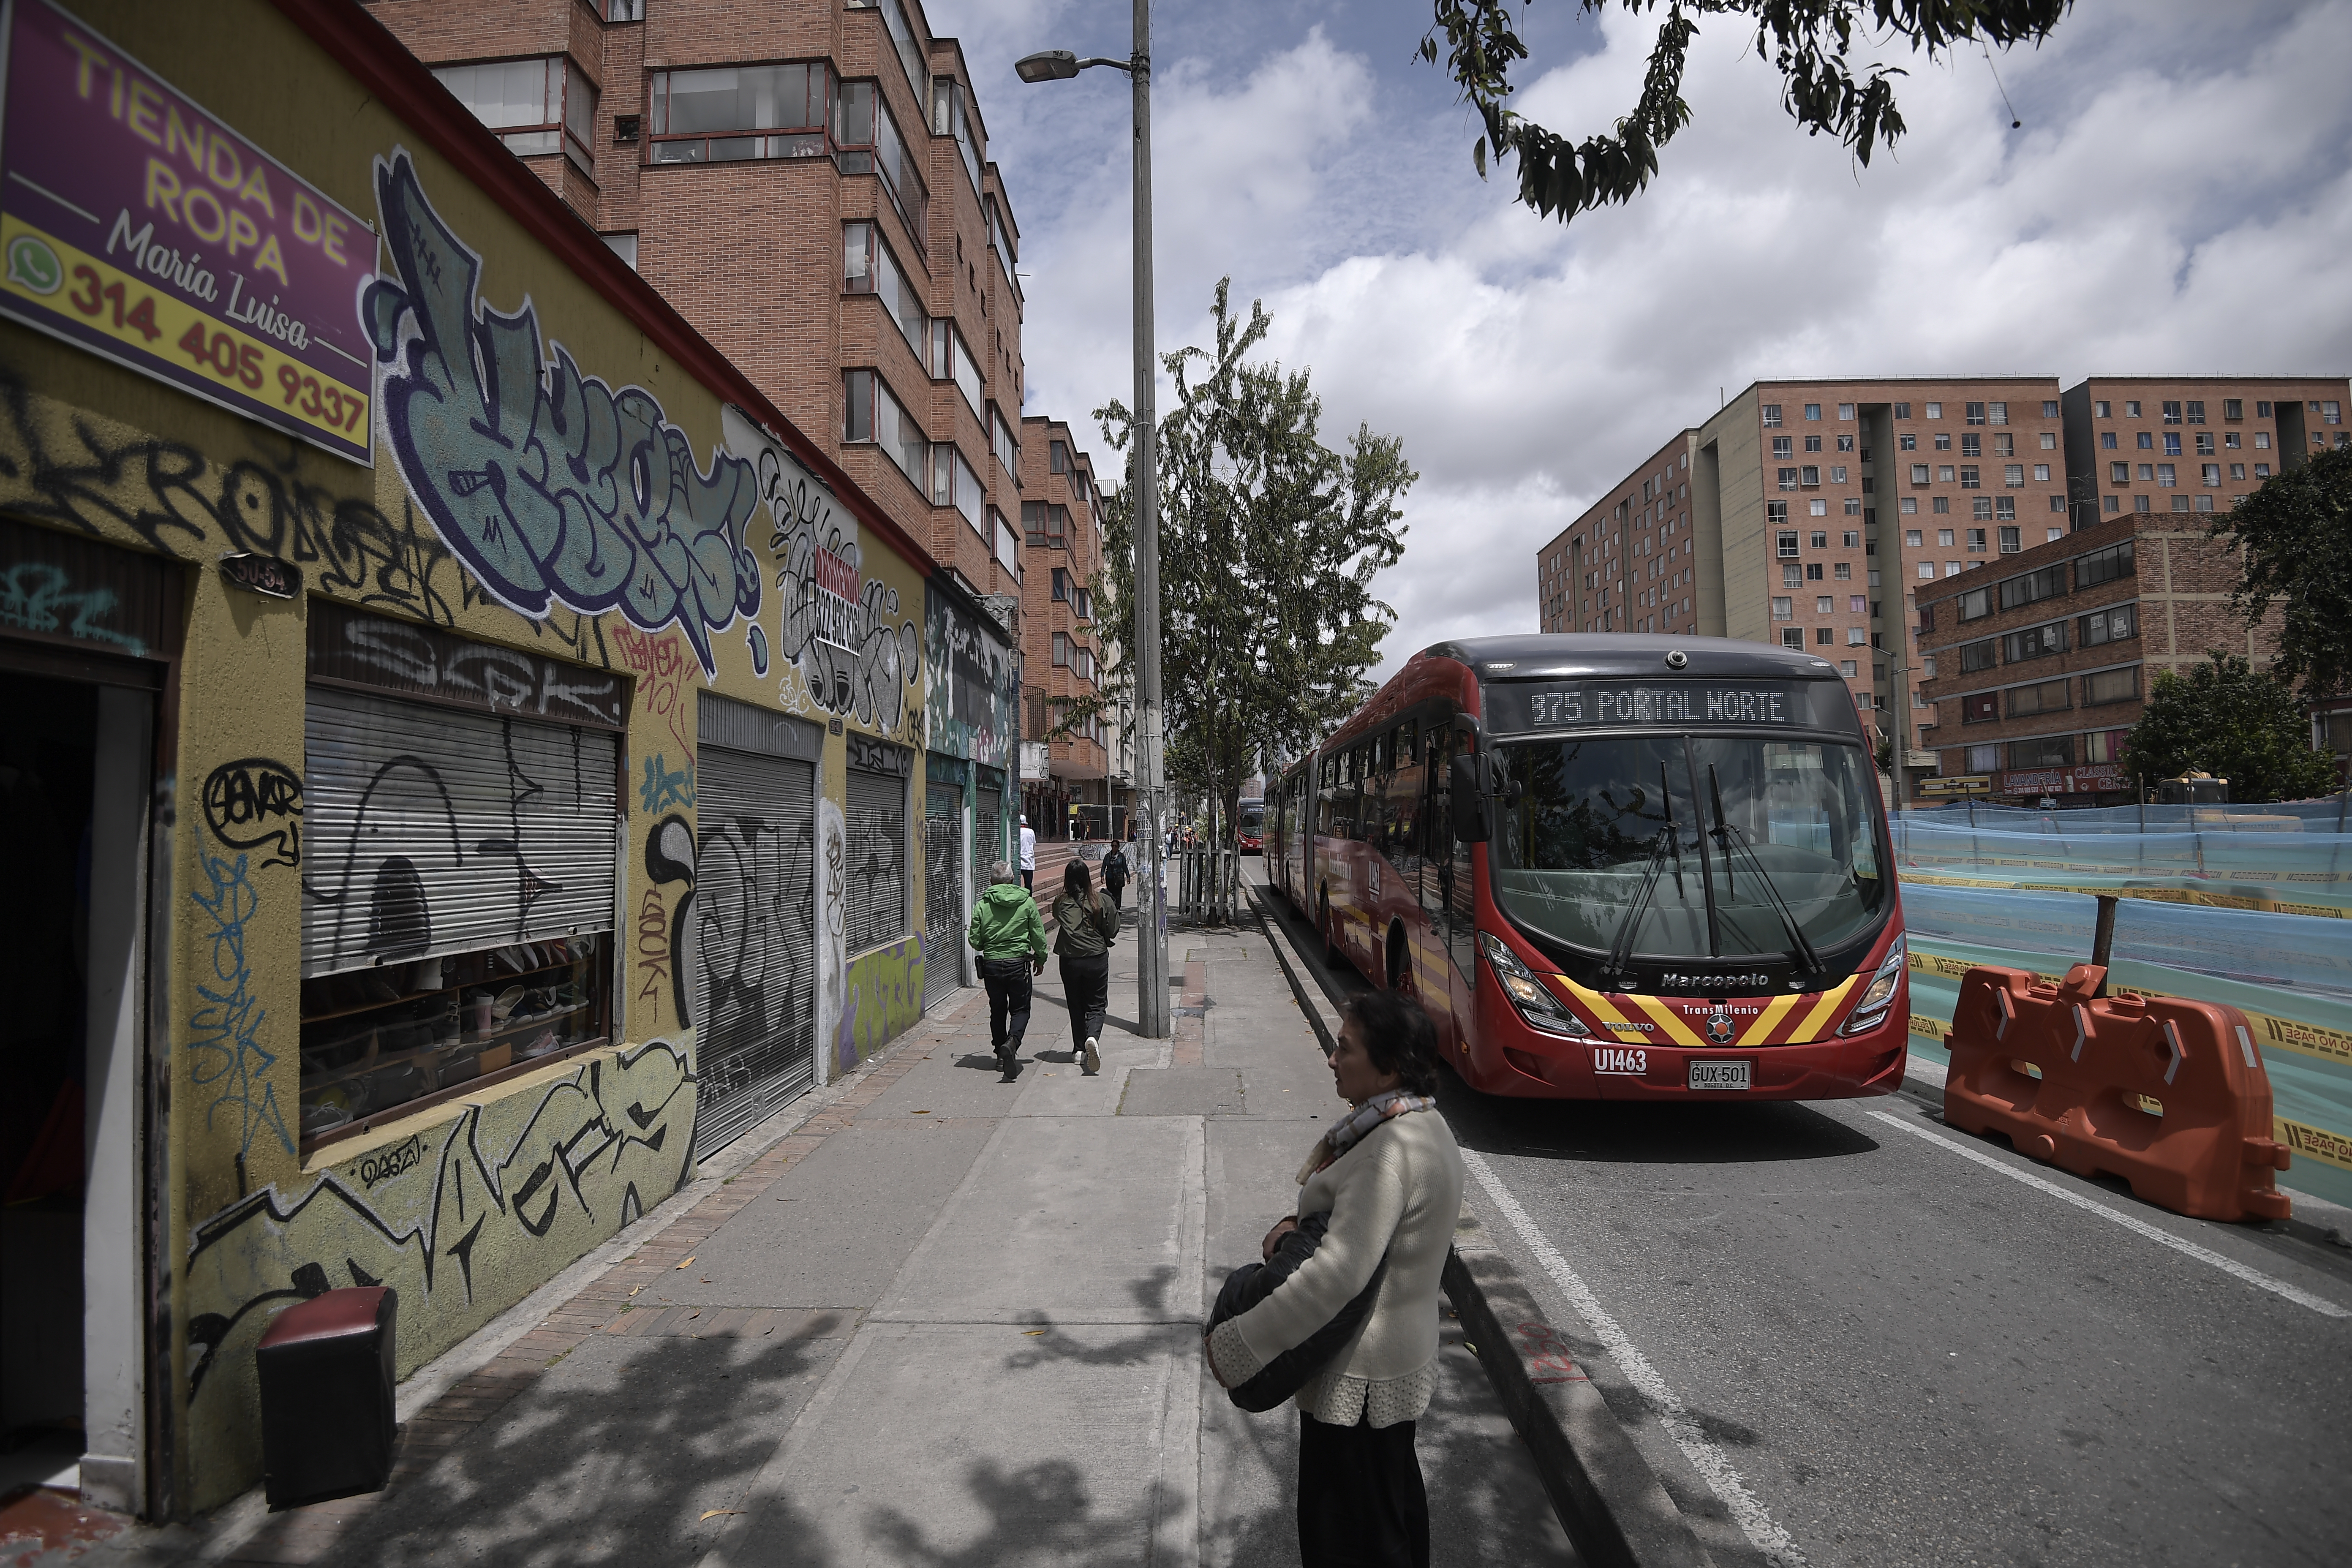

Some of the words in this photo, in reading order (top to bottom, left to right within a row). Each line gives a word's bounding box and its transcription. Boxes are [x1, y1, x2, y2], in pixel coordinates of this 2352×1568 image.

[63, 33, 274, 218] TIENDA
[294, 193, 348, 266] DE
[147, 158, 288, 286] ROPA
[106, 207, 219, 303] María
[226, 274, 311, 351] Luisa
[70, 265, 161, 343] 314
[178, 322, 264, 389] 405
[277, 365, 364, 432] 9337
[816, 543, 860, 608] ARRIENDO
[817, 587, 830, 641] 322
[832, 595, 846, 647] 932
[1598, 690, 1700, 721] PORTAL
[1706, 691, 1786, 721] NORTE
[1369, 861, 1380, 891] U1463
[1661, 972, 1769, 988] Marcopolo
[1602, 1021, 1655, 1032] VOLVO
[1683, 1005, 1759, 1015] TransMilenio
[1595, 1049, 1647, 1072] U1463
